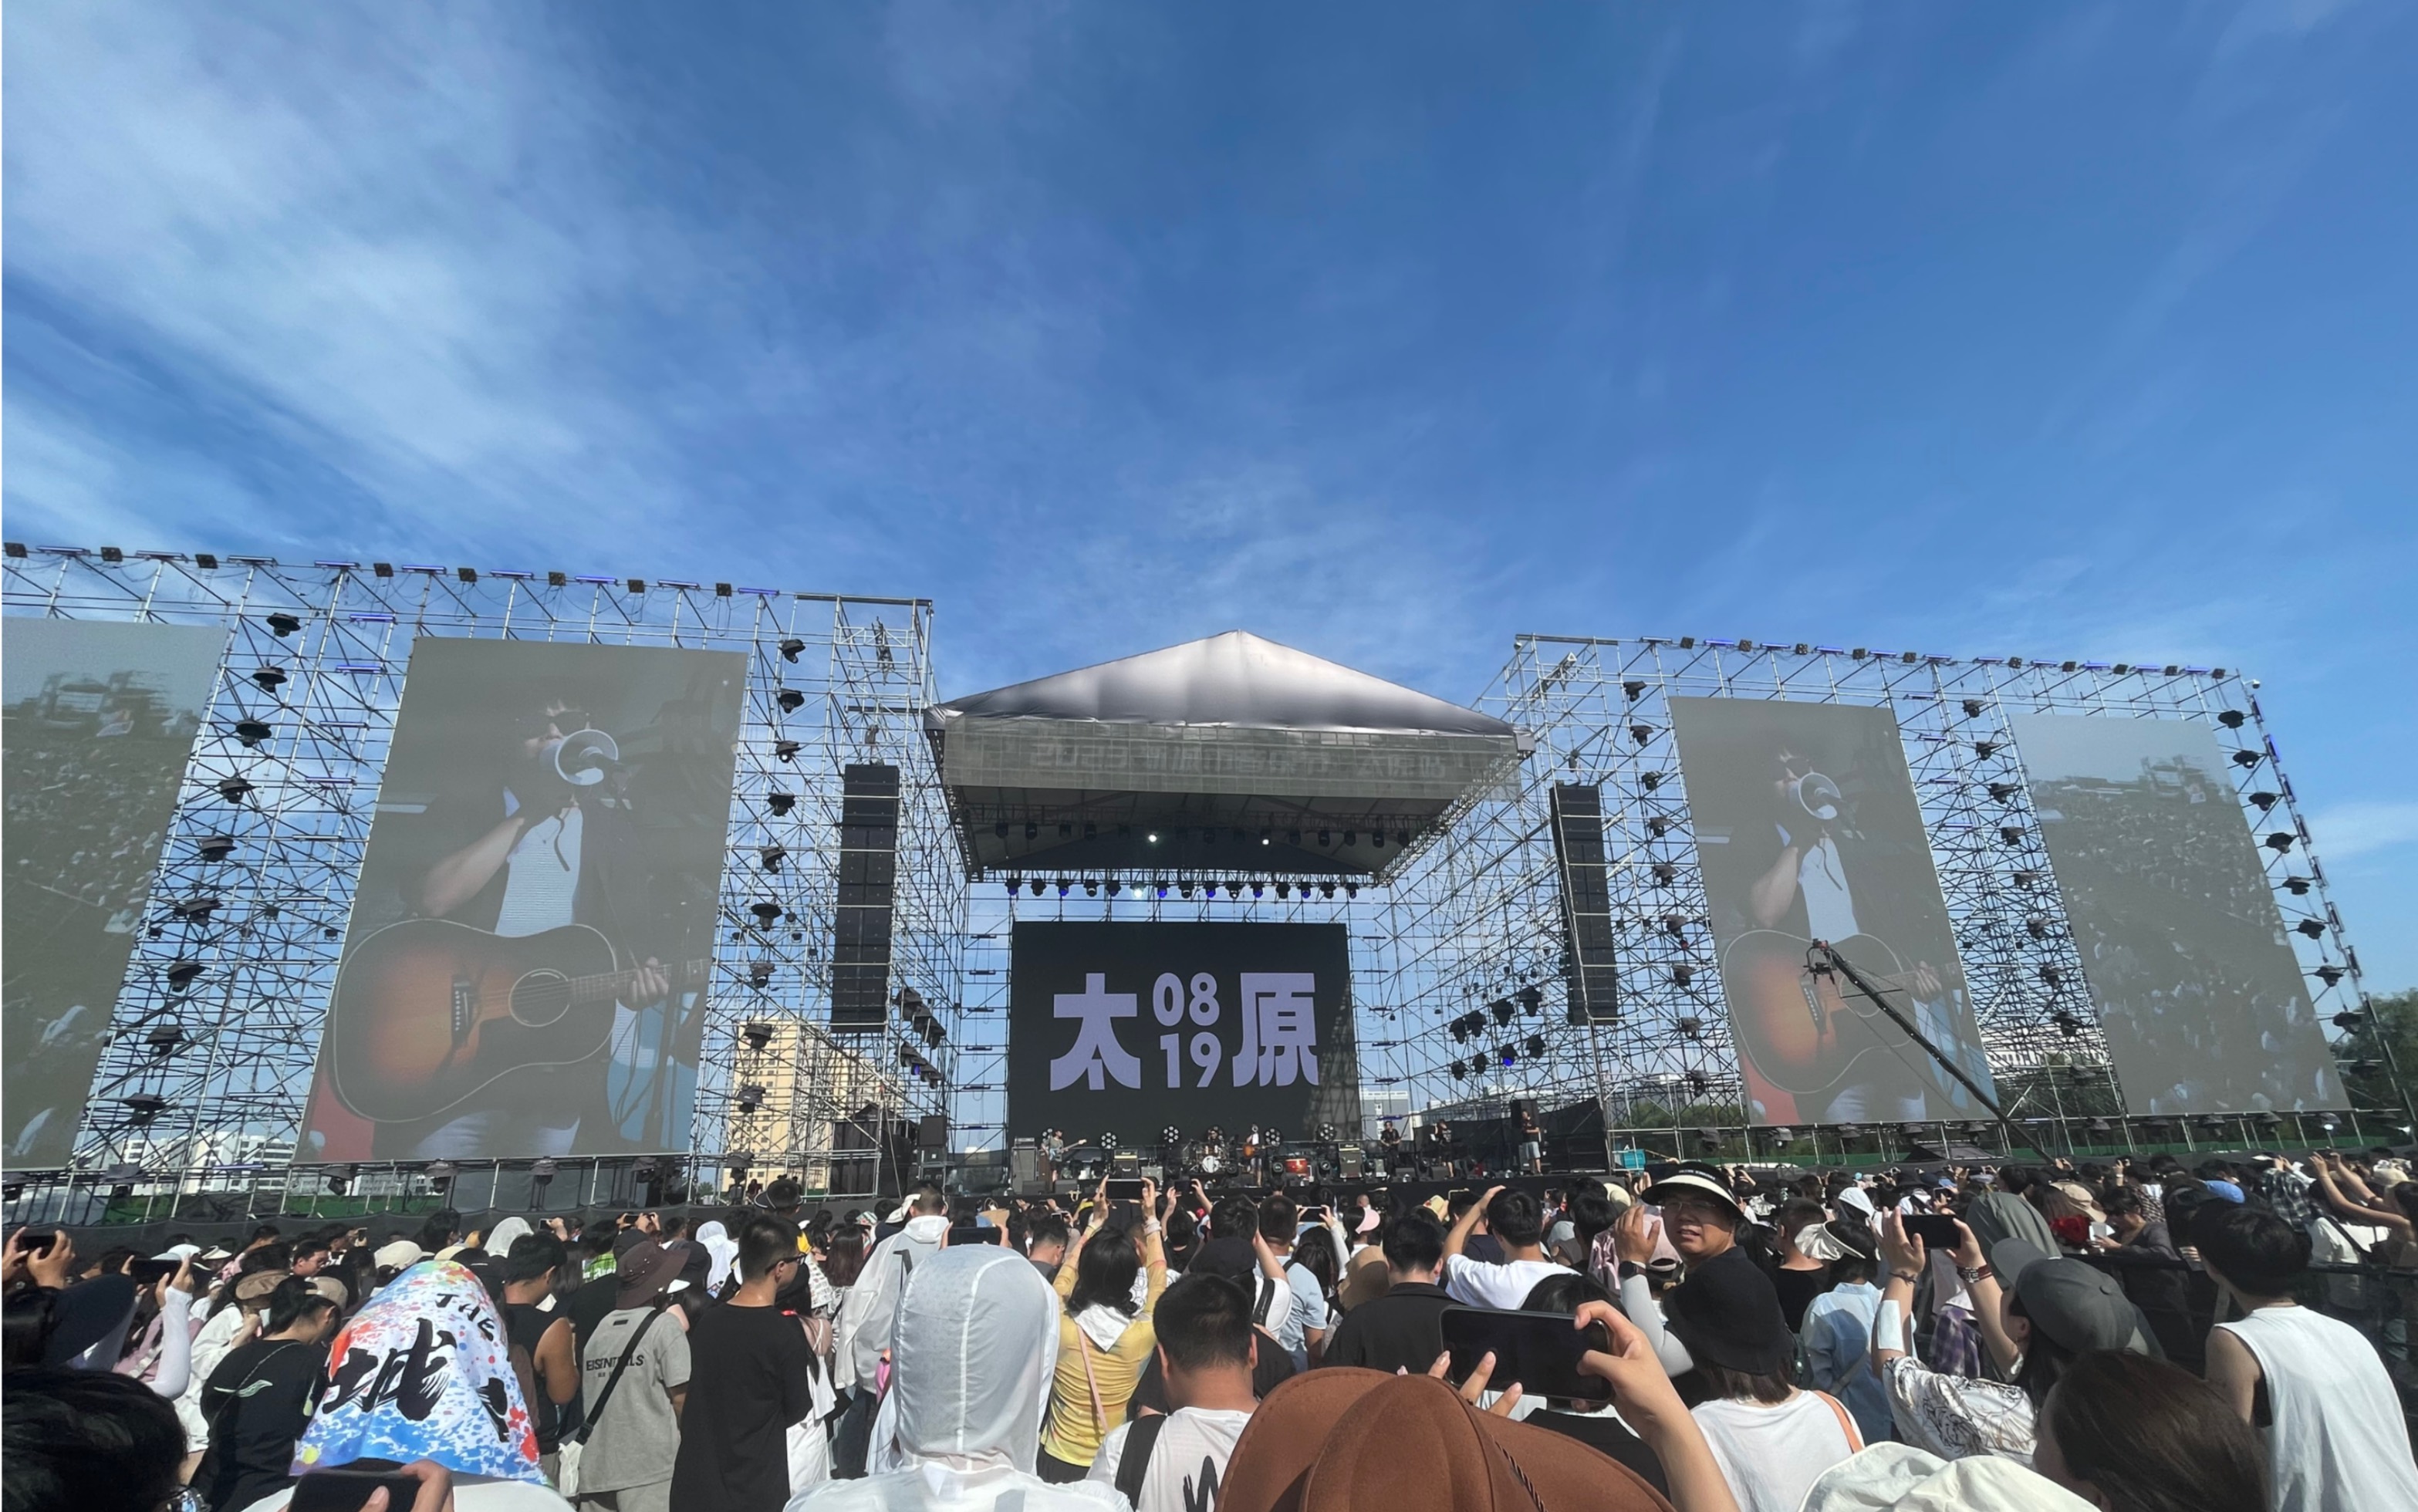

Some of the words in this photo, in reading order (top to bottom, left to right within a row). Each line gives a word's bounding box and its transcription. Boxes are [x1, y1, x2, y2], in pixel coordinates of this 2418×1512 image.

[1152, 972, 1221, 1027] 08
[1049, 972, 1141, 1092] 太
[1231, 972, 1319, 1088] 原
[1160, 1031, 1222, 1088] 19
[435, 1293, 495, 1342] THE
